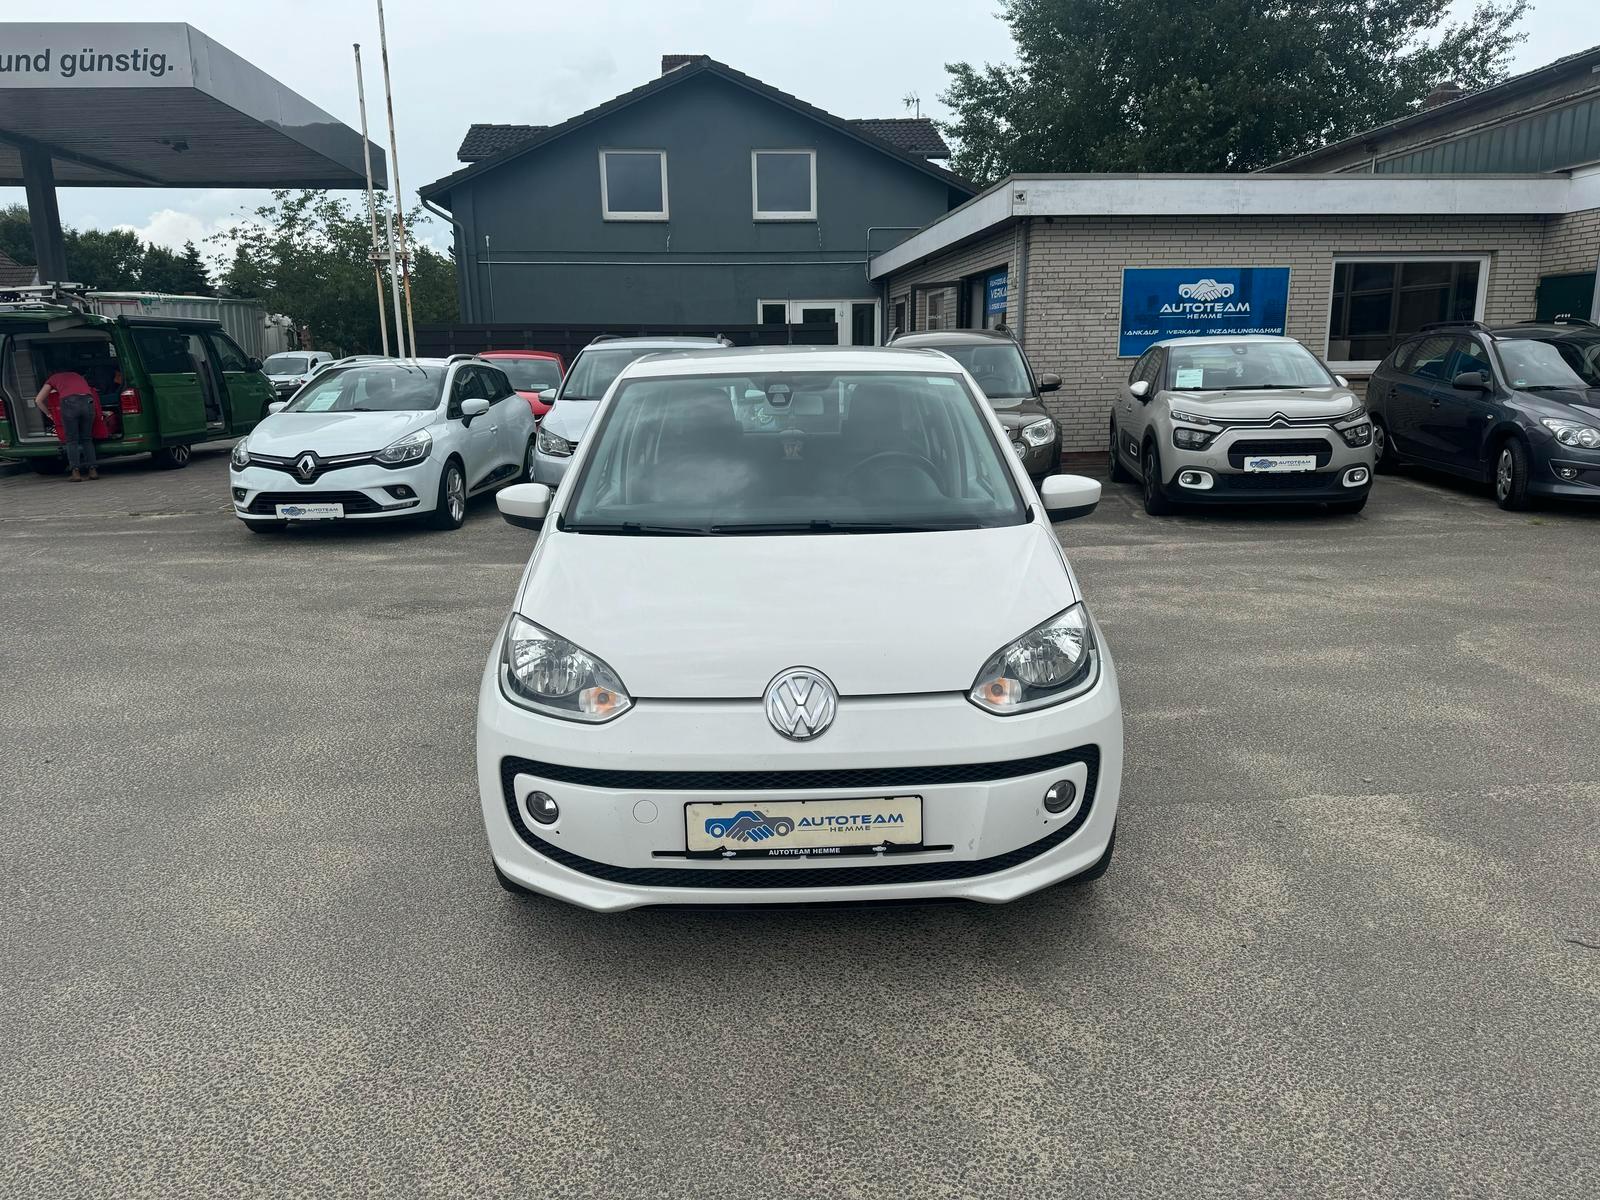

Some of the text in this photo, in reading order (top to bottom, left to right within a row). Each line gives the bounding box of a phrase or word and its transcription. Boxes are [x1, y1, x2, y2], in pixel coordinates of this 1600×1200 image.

[0, 48, 174, 77] und günstig.
[1159, 302, 1251, 313] AUTOTEAM
[797, 813, 904, 827] AUTOTEAM
[829, 825, 871, 833] HEMME
[768, 847, 841, 856] AUTOTEAM HEMME
